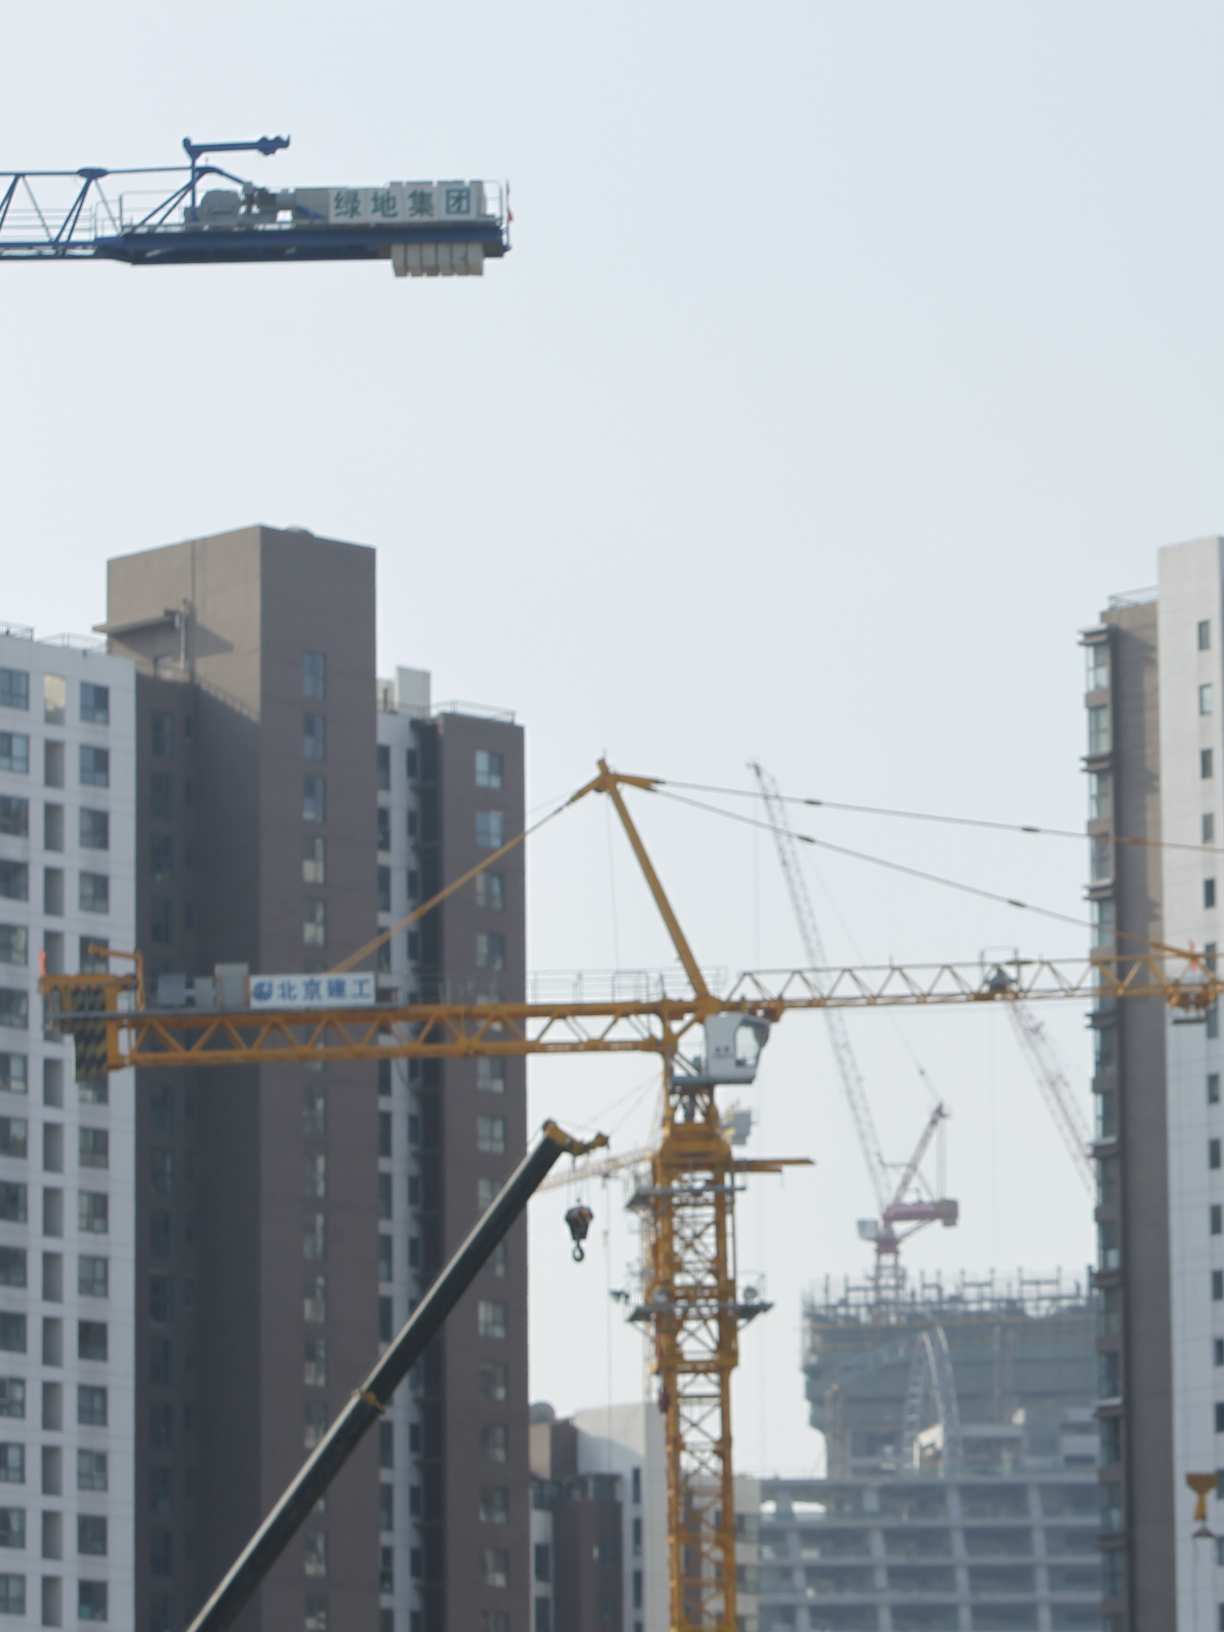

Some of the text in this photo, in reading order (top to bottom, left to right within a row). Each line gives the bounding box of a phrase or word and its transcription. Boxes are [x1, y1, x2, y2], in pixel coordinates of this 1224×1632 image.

[334, 188, 471, 218] 绿地集团
[277, 977, 371, 1000] 北京建工
